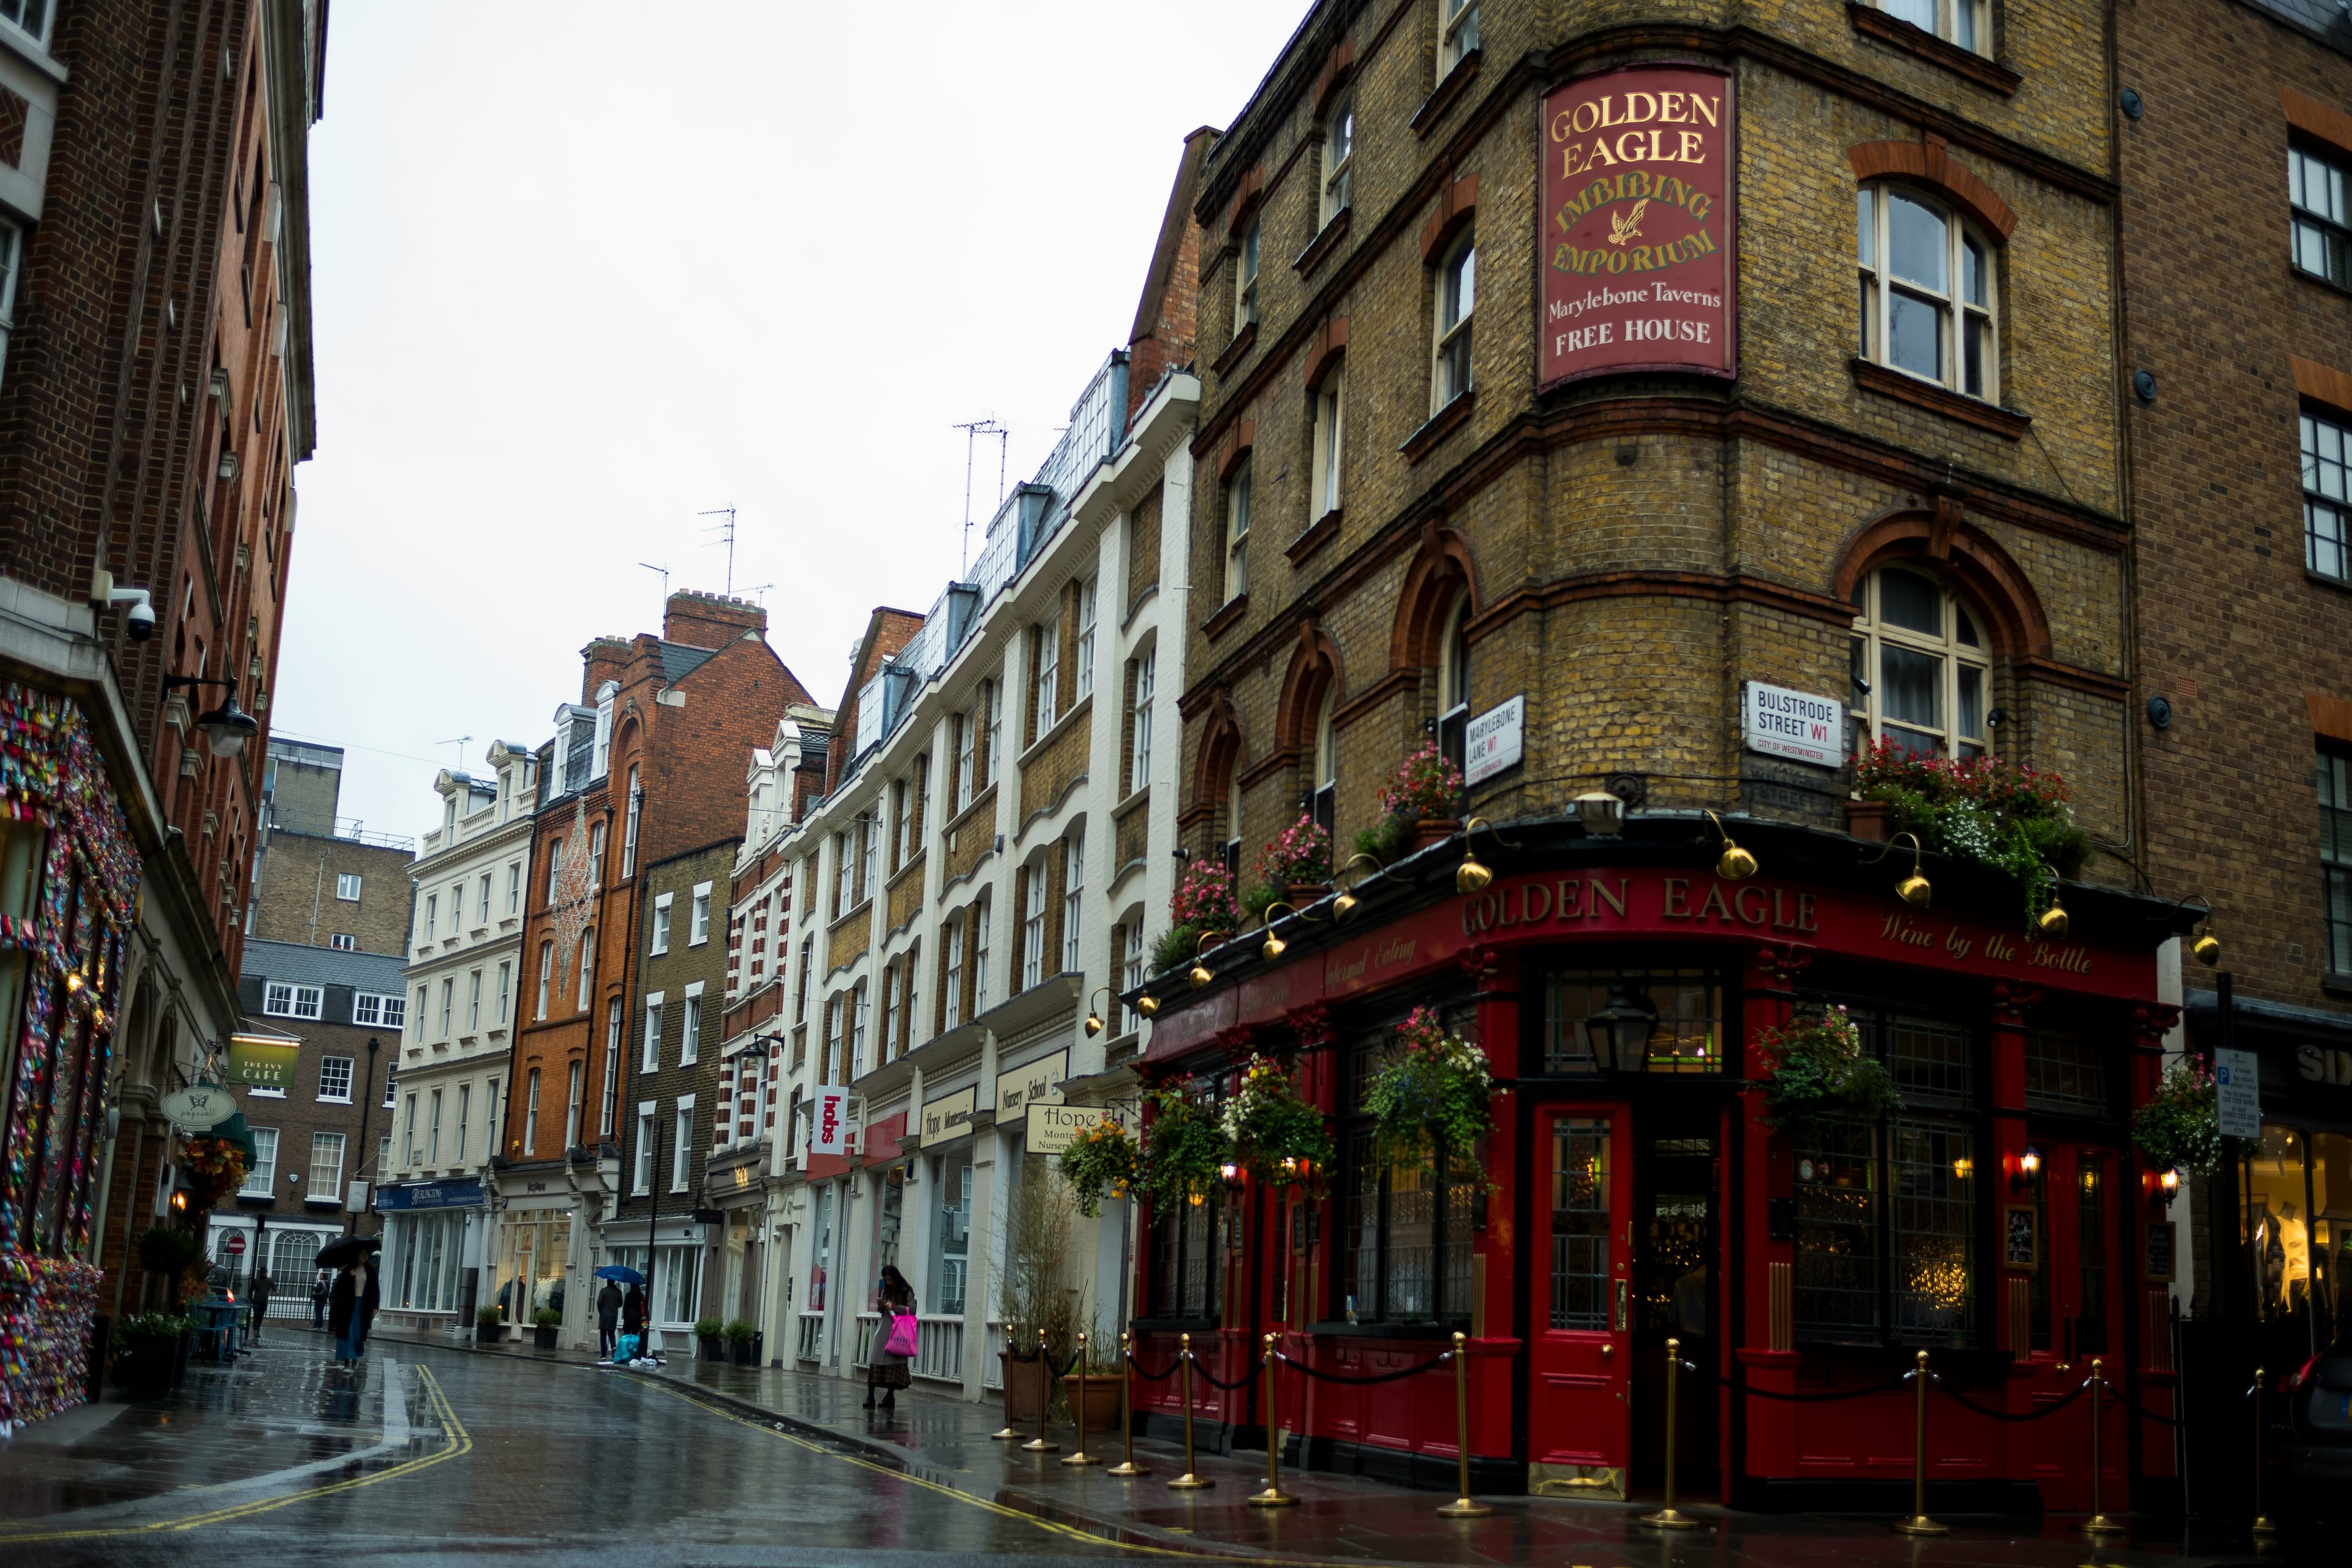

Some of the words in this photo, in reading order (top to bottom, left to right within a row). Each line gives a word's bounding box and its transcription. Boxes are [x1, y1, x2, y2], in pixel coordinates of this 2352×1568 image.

[1551, 91, 1720, 143] GOLDEN
[1561, 129, 1706, 179] EAGLE
[1555, 170, 1713, 235] IMBIBING
[1552, 228, 1718, 275] EMPORIUM
[1548, 287, 1648, 323] Marylebone
[1650, 281, 1721, 307] Taverns
[1555, 322, 1613, 356] FREE
[1624, 318, 1711, 344] HOUSE
[1469, 705, 1515, 744] MARYLEBONE
[1758, 690, 1833, 723] BULSTRODE
[1758, 712, 1806, 737] STREET
[1810, 723, 1827, 742] W1
[1469, 741, 1485, 764] LANE
[1487, 734, 1496, 754] W1
[1757, 739, 1771, 748] CITY
[1773, 742, 1780, 751] OF
[1782, 744, 1823, 760] WESTMINSTER
[1461, 878, 1630, 936] GOLDEN
[1660, 877, 1819, 932] EAGLE
[1879, 910, 1934, 947] Wine
[1945, 925, 1972, 962] by
[1985, 933, 2017, 961] the
[2027, 940, 2093, 974] Bottle
[1324, 946, 1370, 991] Informal
[1374, 936, 1417, 968] Eating
[1002, 1090, 1023, 1110] Nursery
[1028, 1074, 1047, 1102] School
[821, 1095, 841, 1144] hobs
[926, 1112, 941, 1140] Hope
[1044, 1108, 1096, 1128] Hope
[1044, 1130, 1075, 1139] Monte
